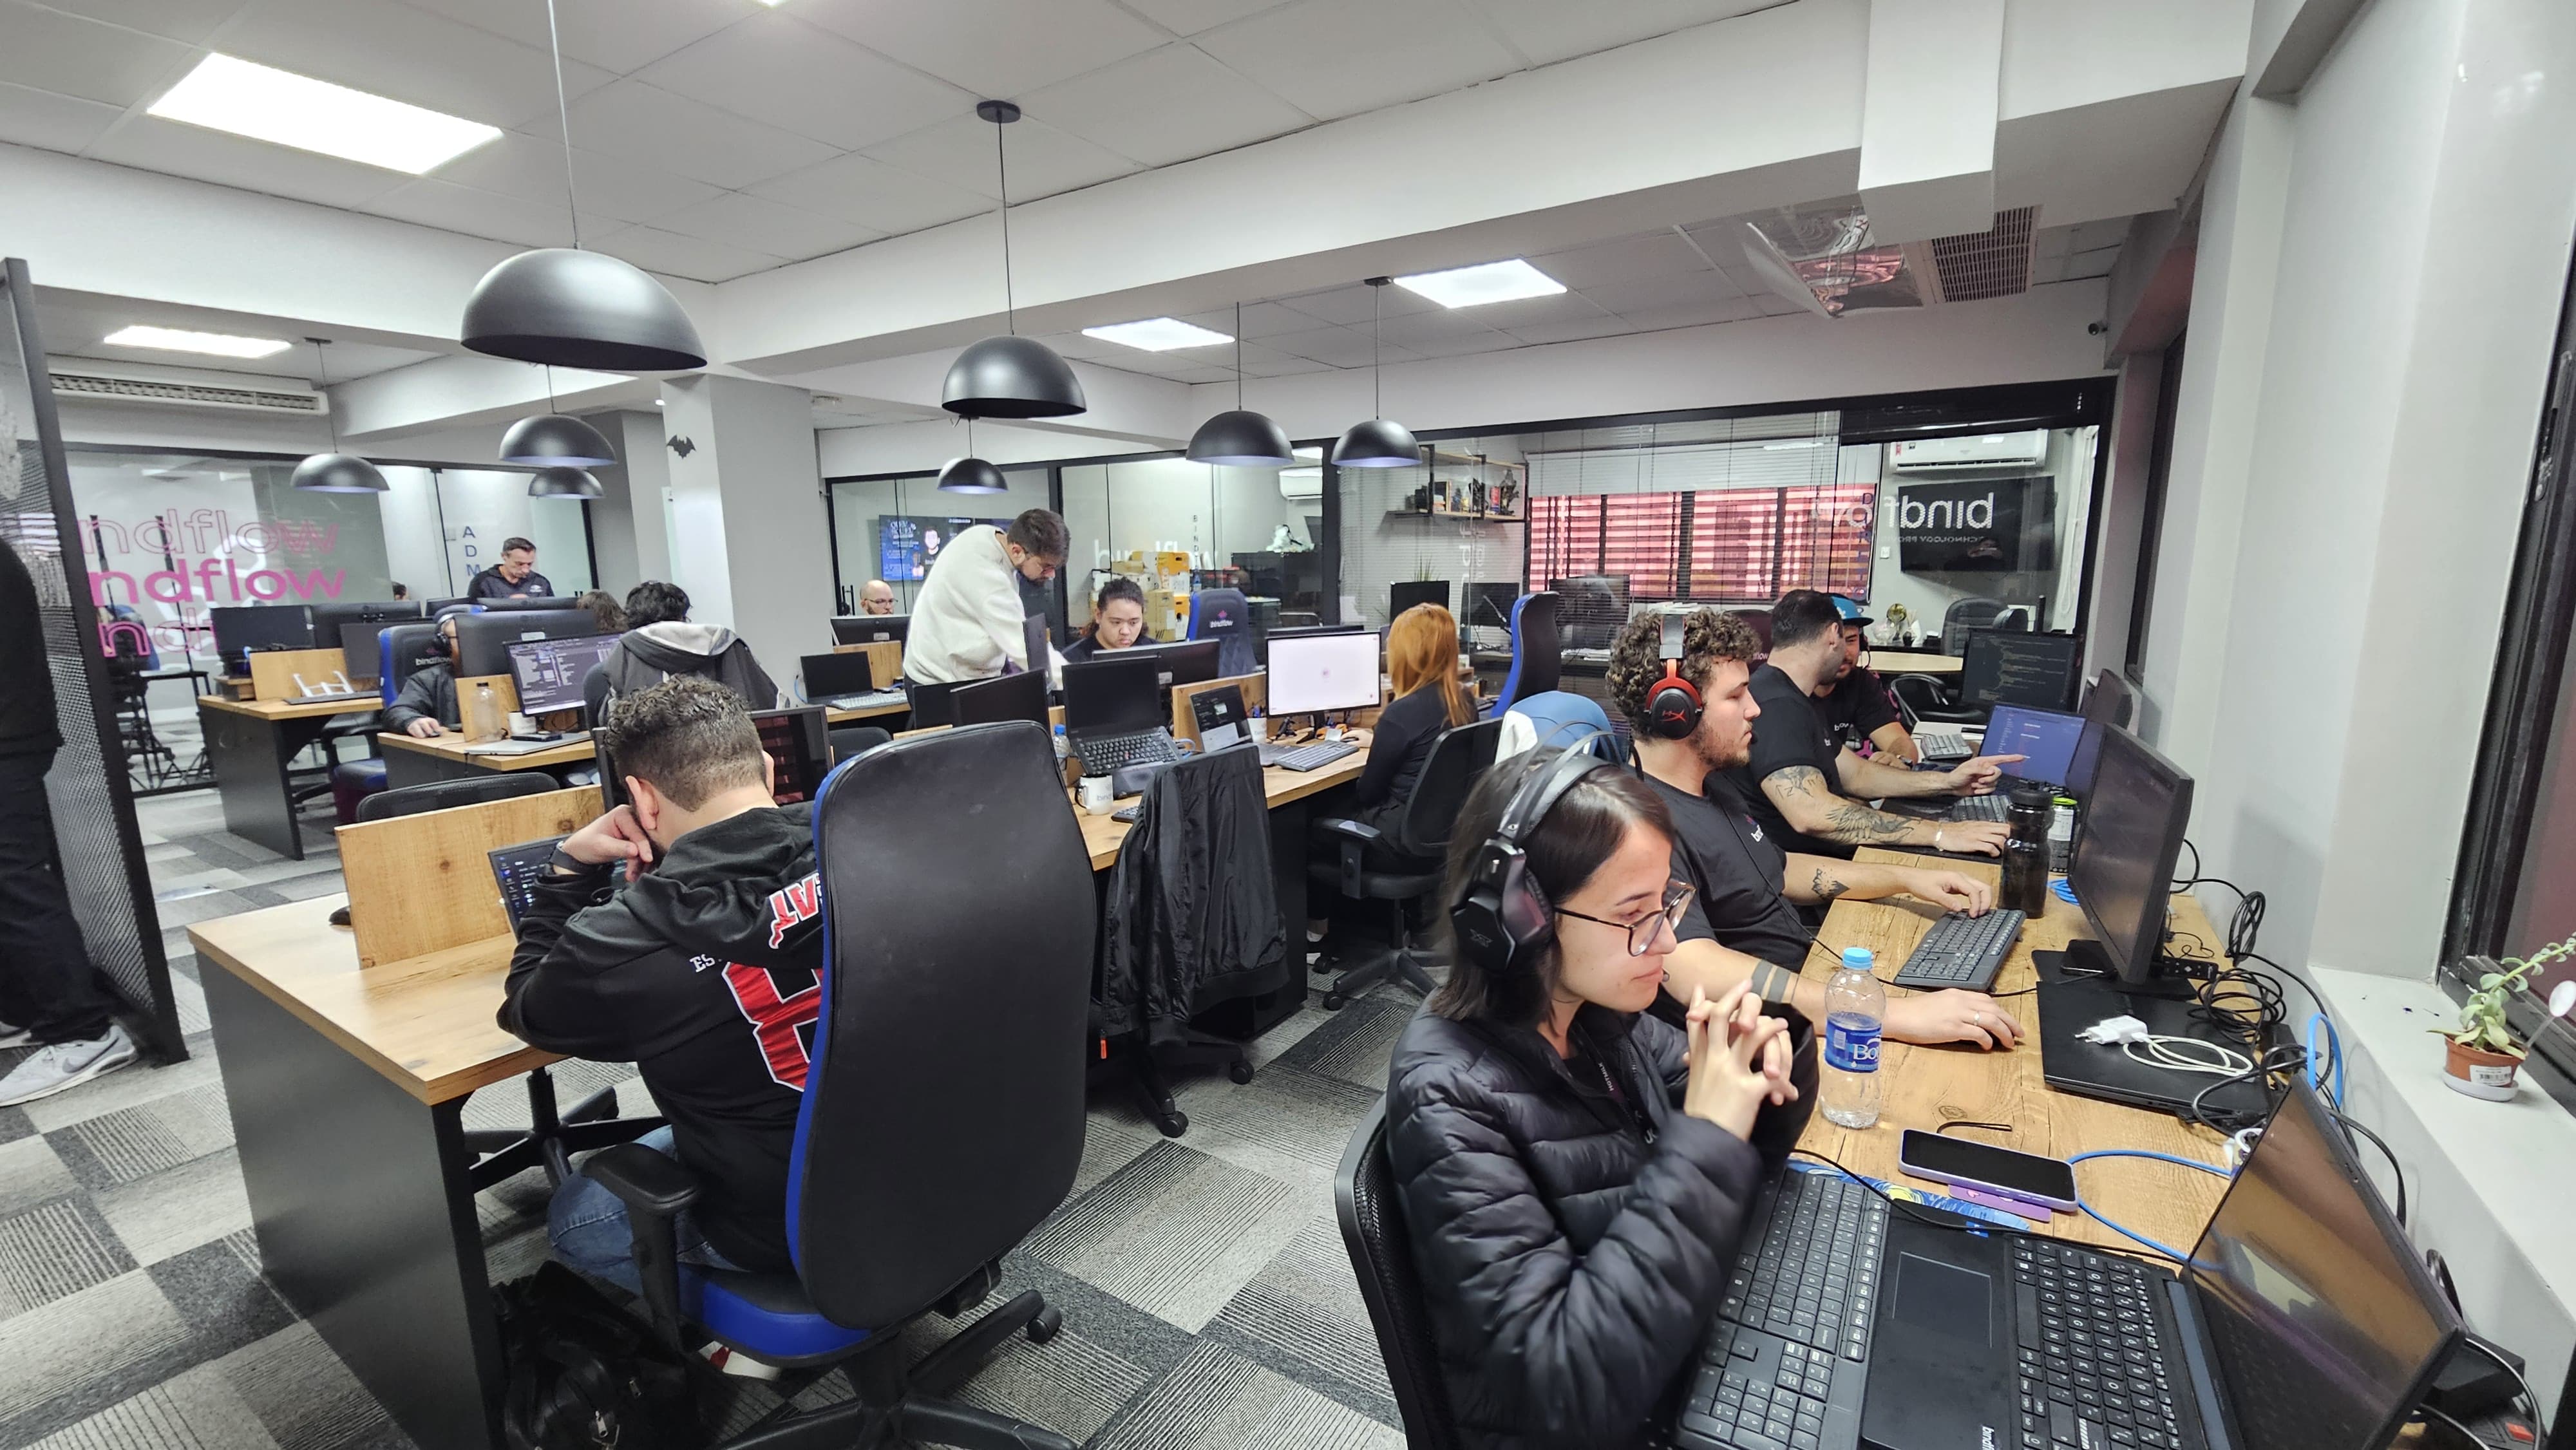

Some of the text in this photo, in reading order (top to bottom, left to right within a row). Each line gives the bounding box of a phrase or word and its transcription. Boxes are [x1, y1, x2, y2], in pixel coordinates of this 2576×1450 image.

[88, 558, 346, 607] ndflow
[98, 608, 218, 658] nd
[689, 954, 722, 972] ES
